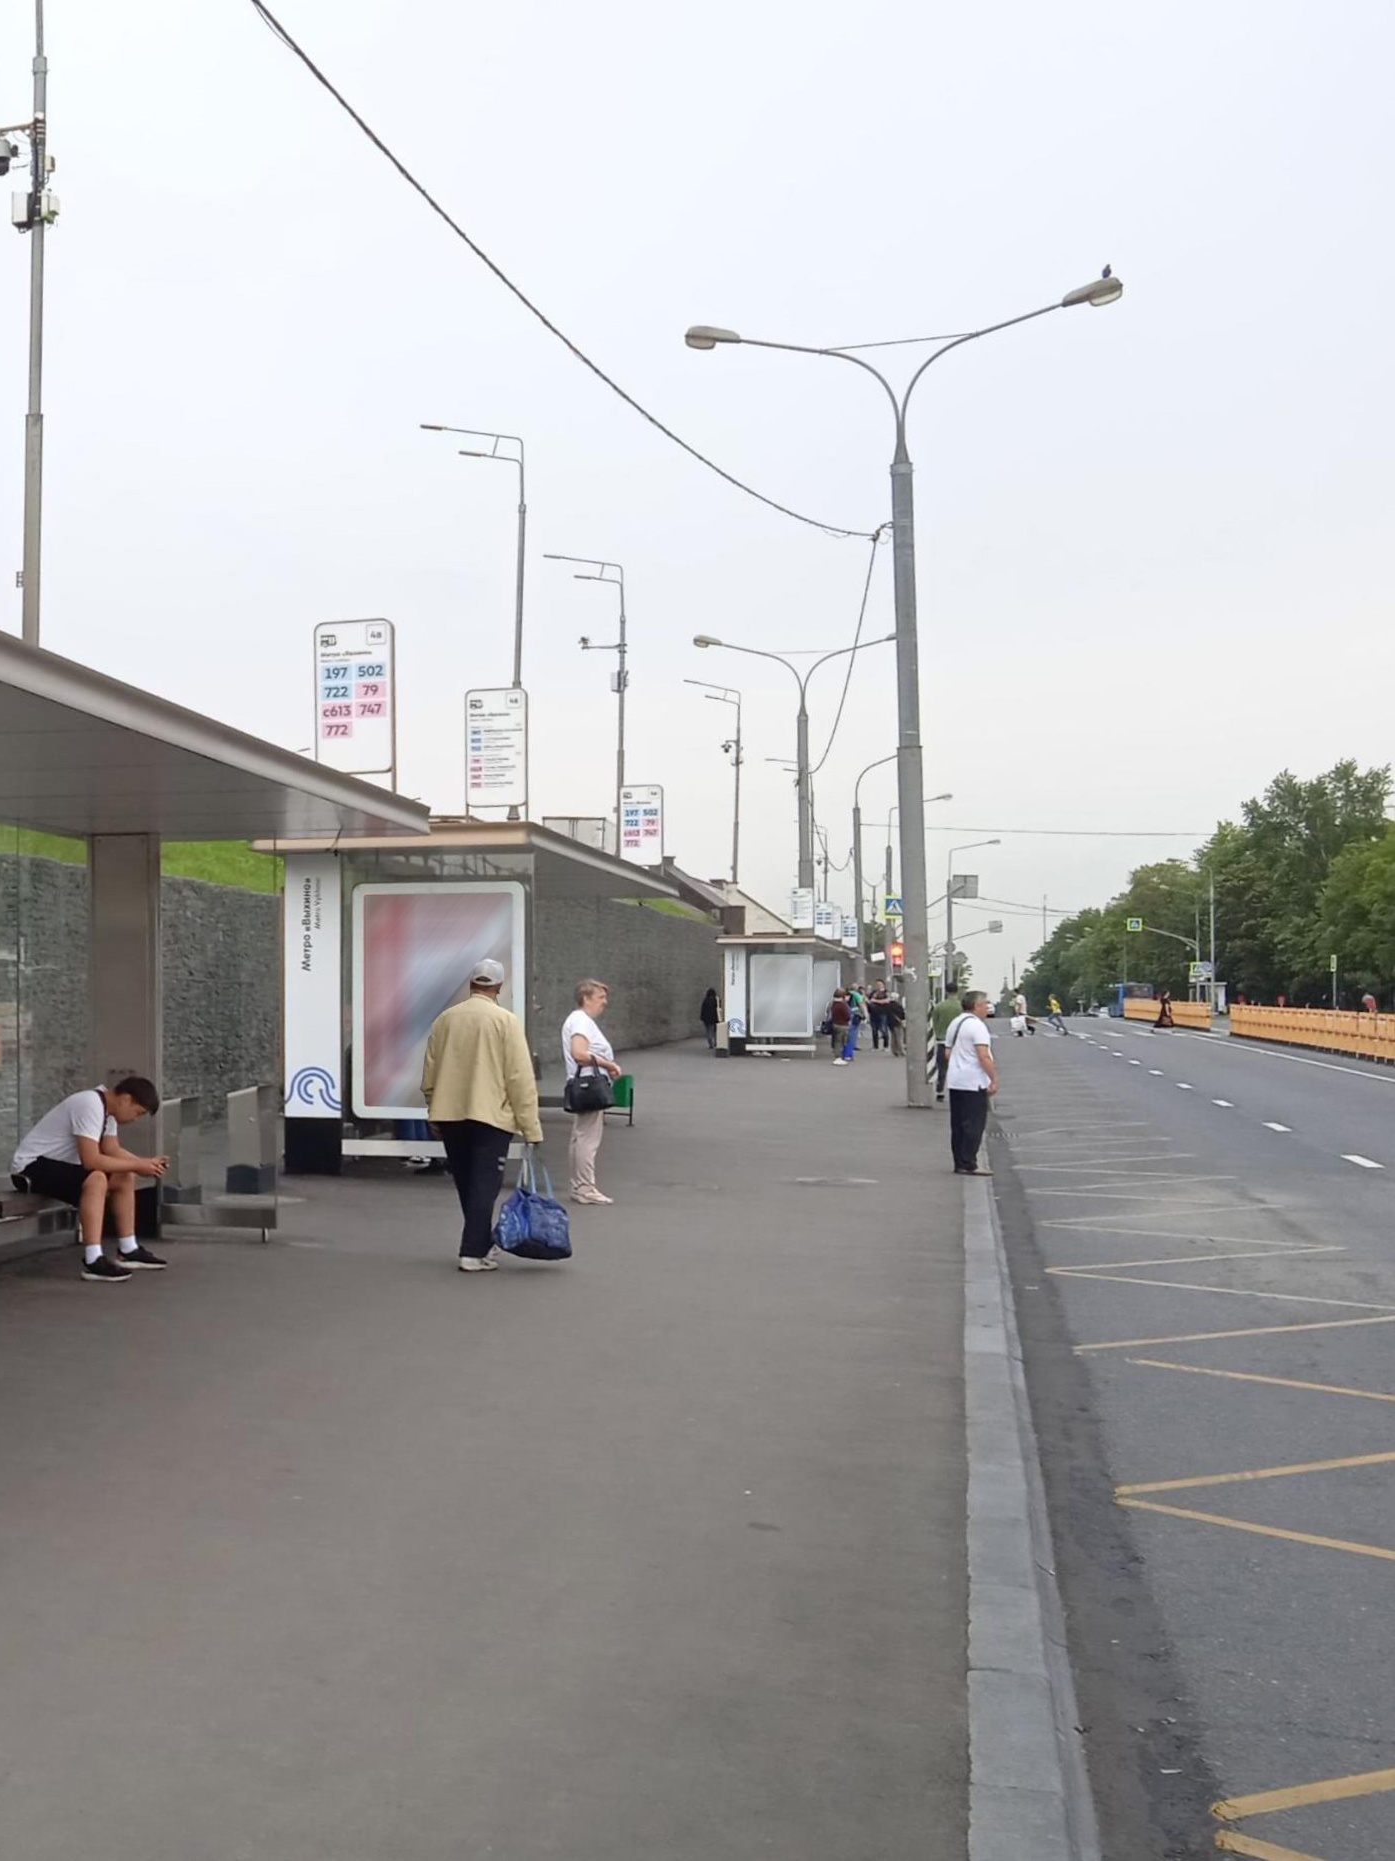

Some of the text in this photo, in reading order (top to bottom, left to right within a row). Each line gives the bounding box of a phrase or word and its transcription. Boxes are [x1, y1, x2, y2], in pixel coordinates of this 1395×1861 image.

[324, 667, 348, 680] 197
[357, 665, 384, 677] 502
[324, 685, 349, 698] 722
[362, 684, 379, 696] 79
[322, 704, 352, 718] с613
[359, 703, 382, 715] 747
[325, 724, 348, 736] 772
[301, 934, 313, 972] Метро
